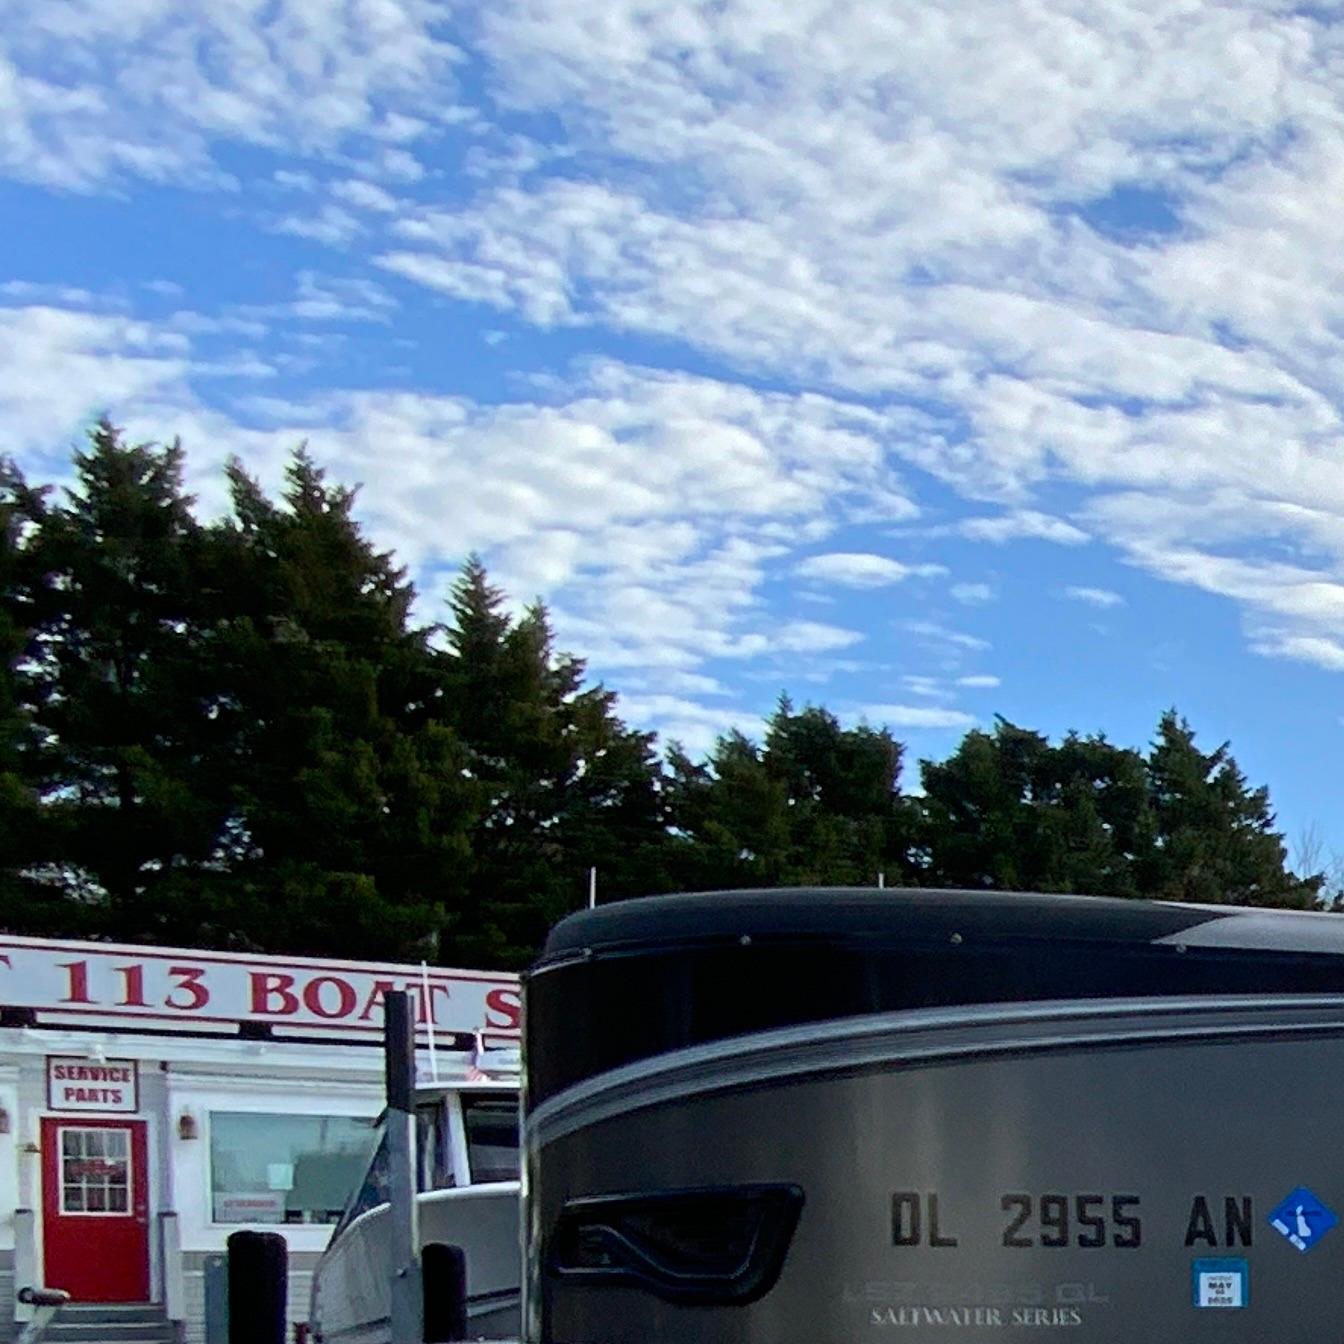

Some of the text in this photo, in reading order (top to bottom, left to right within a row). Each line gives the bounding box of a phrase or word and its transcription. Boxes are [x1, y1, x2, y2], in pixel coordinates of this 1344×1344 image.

[55, 959, 210, 1010] 113
[247, 971, 450, 1025] BOAT
[54, 1064, 131, 1083] SERVICE
[64, 1086, 123, 1104] PARTS
[890, 1191, 958, 1248] DL
[1001, 1193, 1142, 1249] 2955
[1184, 1195, 1254, 1248] AN
[870, 1305, 1082, 1327] SALTWATER SERIES
